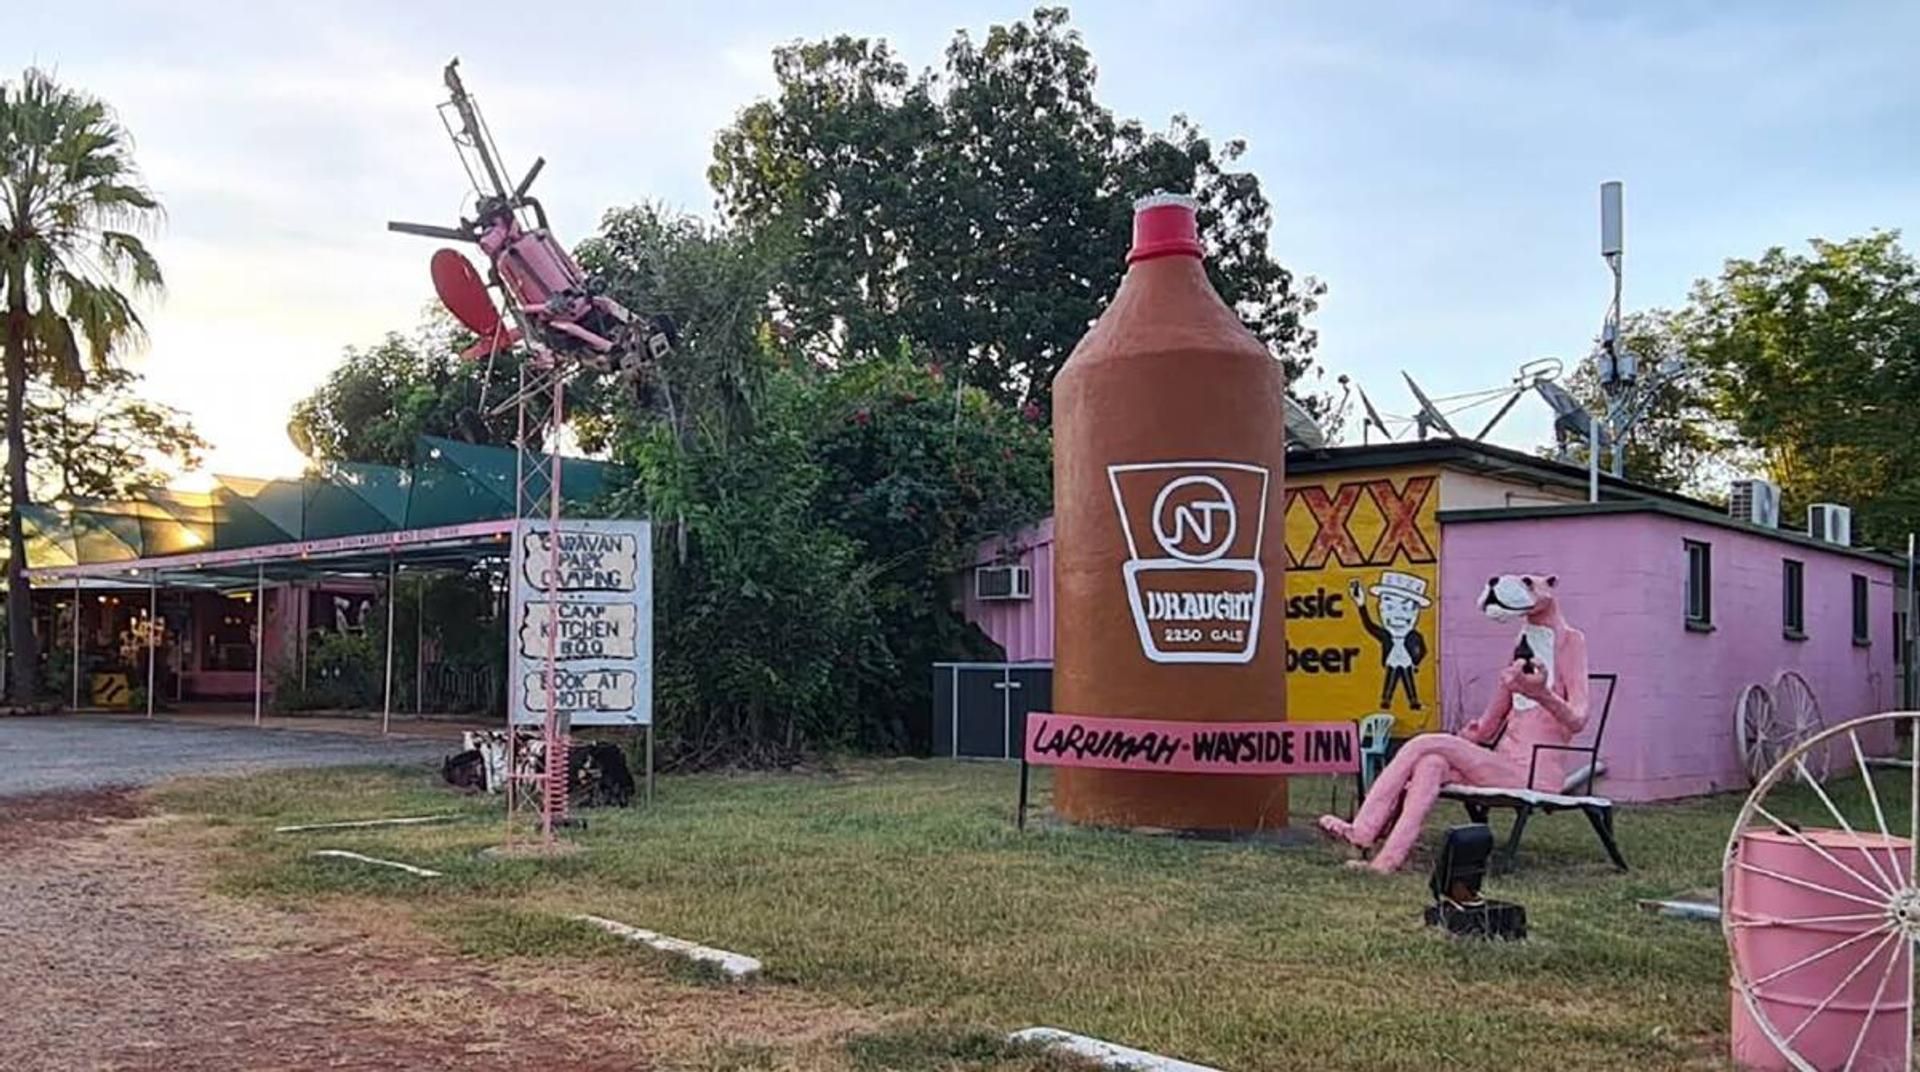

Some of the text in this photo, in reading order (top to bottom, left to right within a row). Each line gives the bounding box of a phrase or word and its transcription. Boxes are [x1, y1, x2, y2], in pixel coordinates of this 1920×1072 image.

[1284, 476, 1437, 571] XX
[558, 551, 604, 567] PARK
[558, 602, 605, 618] CAMP
[1145, 590, 1255, 621] DRAUGHT
[1285, 587, 1344, 619] ssic
[597, 673, 622, 690] AT
[1304, 730, 1352, 762] INN
